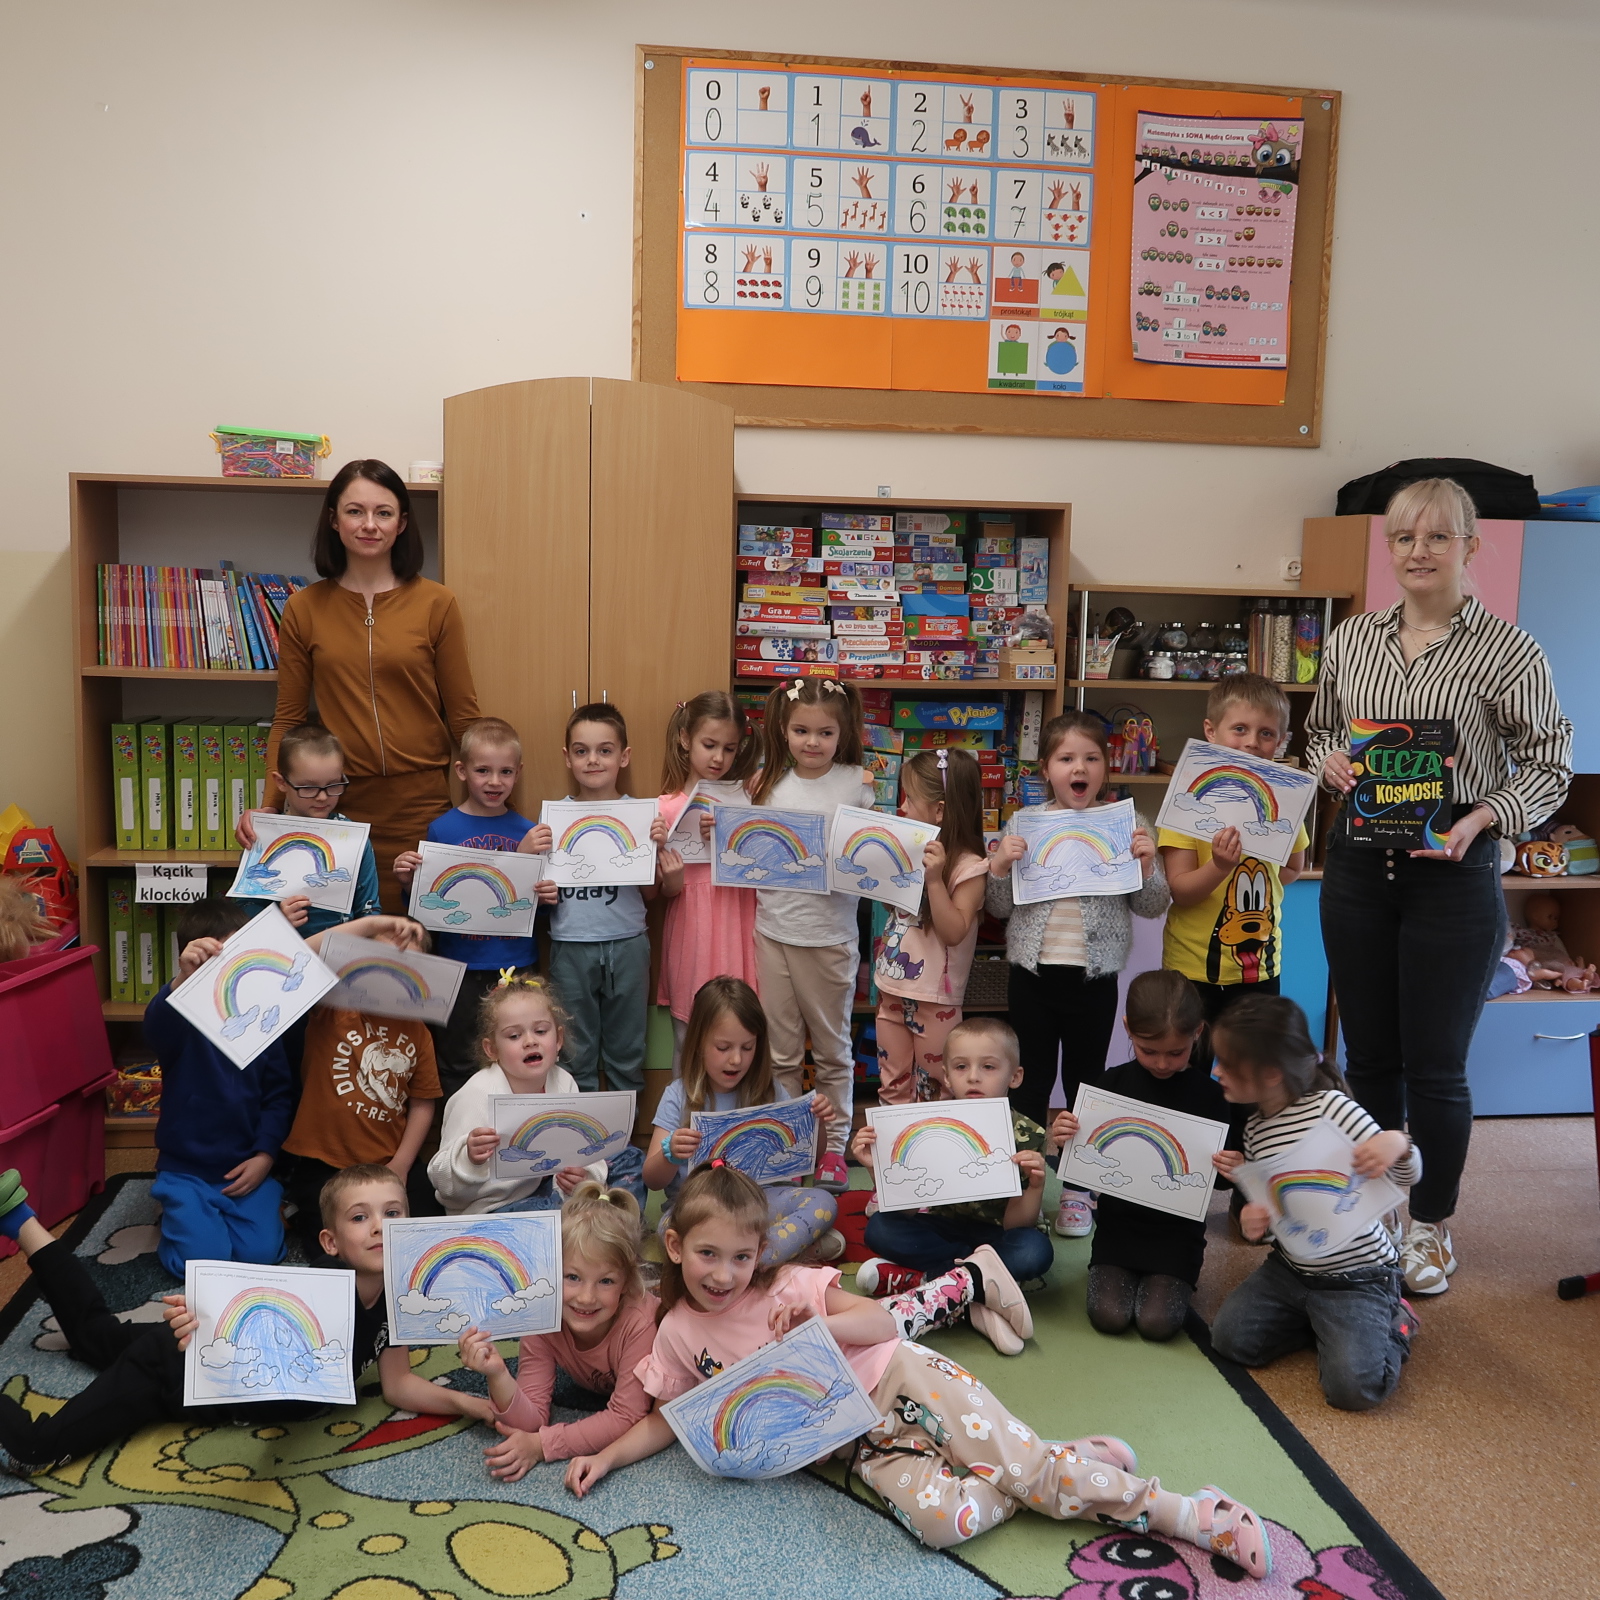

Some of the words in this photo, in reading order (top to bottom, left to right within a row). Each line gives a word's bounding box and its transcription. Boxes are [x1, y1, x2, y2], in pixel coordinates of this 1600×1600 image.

[706, 80, 721, 100] 0
[813, 86, 823, 106] 1
[913, 92, 927, 113] 2
[1015, 99, 1028, 119] 3
[811, 113, 820, 146] 1
[911, 119, 927, 153] 2
[1147, 129, 1180, 139] Matematyka
[1186, 132, 1204, 141] SOWĄ
[1205, 134, 1224, 142] Mądrą
[1012, 125, 1029, 158] 3
[705, 161, 719, 182] 4
[810, 168, 823, 188] 5
[912, 174, 925, 194] 6
[1013, 179, 1026, 199] 7
[704, 189, 720, 222] 4
[807, 194, 823, 227] 5
[909, 201, 926, 233] 6
[1010, 205, 1027, 238] 7
[1199, 235, 1204, 243] 3
[705, 243, 717, 264] 8
[808, 248, 821, 268] 9
[903, 254, 928, 274] 10
[703, 270, 720, 304] 8
[806, 275, 822, 308] 9
[900, 280, 930, 313] 10
[1165, 294, 1170, 302] 3
[1176, 295, 1181, 303] 5
[1192, 296, 1197, 304] 8
[1000, 308, 1032, 317] prostokąt
[1053, 310, 1074, 319] trójkąt
[1164, 330, 1170, 338] 4
[1176, 331, 1181, 339] 3
[1193, 332, 1197, 340] 1
[828, 546, 872, 557] Skojarzenia
[743, 643, 757, 651] Trefl
[921, 707, 949, 716] Inspektor
[948, 705, 998, 727] Pytanko
[932, 731, 946, 739] 25
[1365, 749, 1443, 782] TĘCZA
[1375, 781, 1444, 804] KOSMOSIE
[153, 865, 194, 880] Kącik
[140, 887, 206, 901] klocków
[355, 1101, 393, 1123] T-RE
